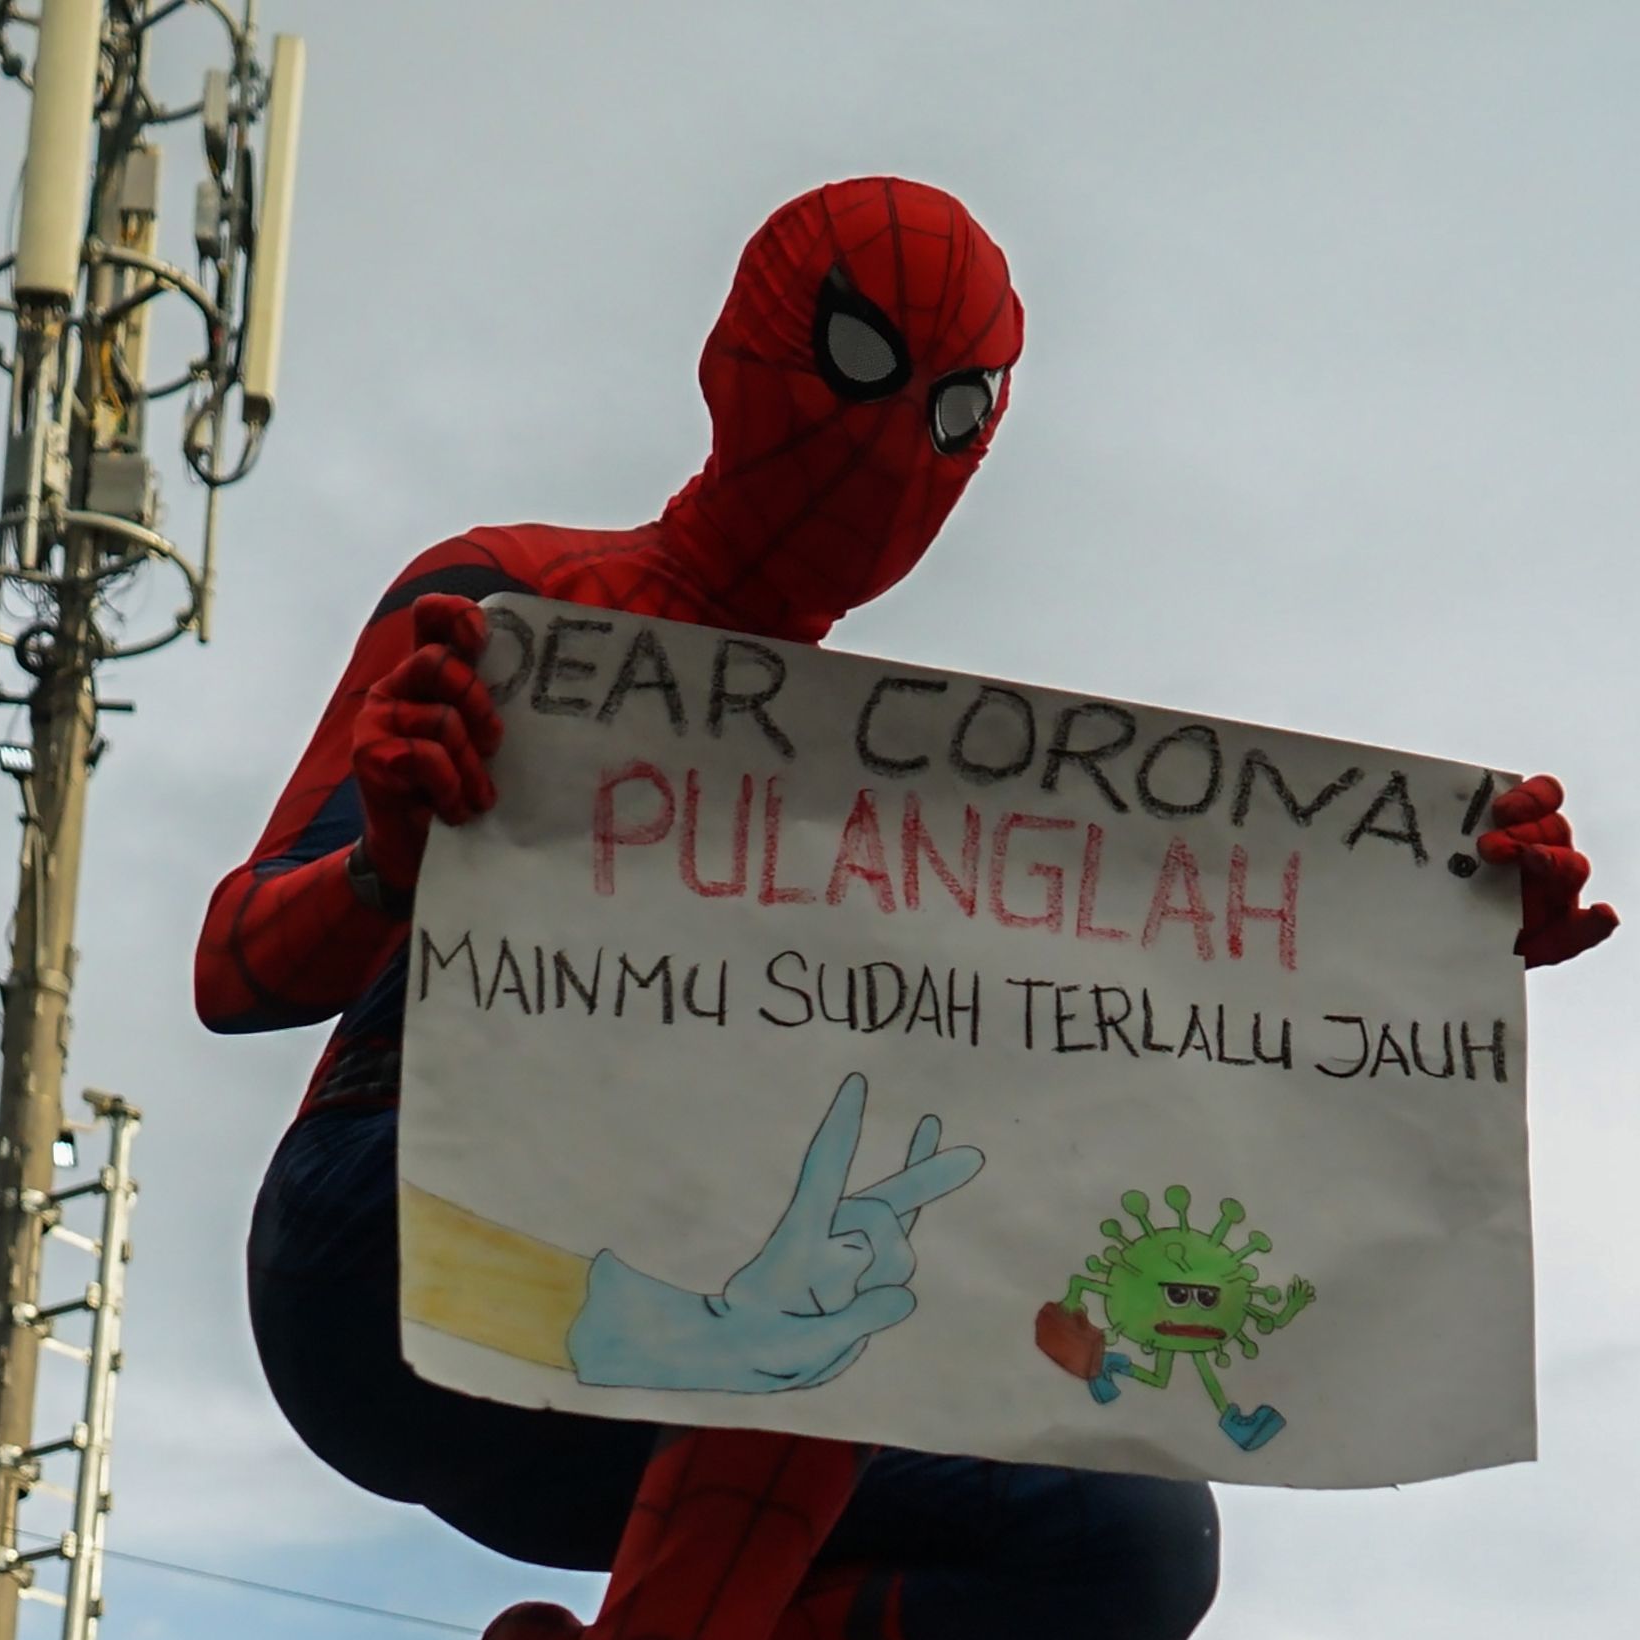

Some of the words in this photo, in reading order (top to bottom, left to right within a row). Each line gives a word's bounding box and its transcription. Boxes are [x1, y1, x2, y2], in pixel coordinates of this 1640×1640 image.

[478, 605, 795, 760] DEAR
[854, 675, 1496, 879] CORONA!
[592, 758, 1304, 972] PULANGLAH
[418, 928, 730, 1029] MAINMU
[763, 949, 982, 1048] SUDAH
[1006, 979, 1295, 1072] TERLALU
[1315, 1014, 1510, 1085] JAUH
